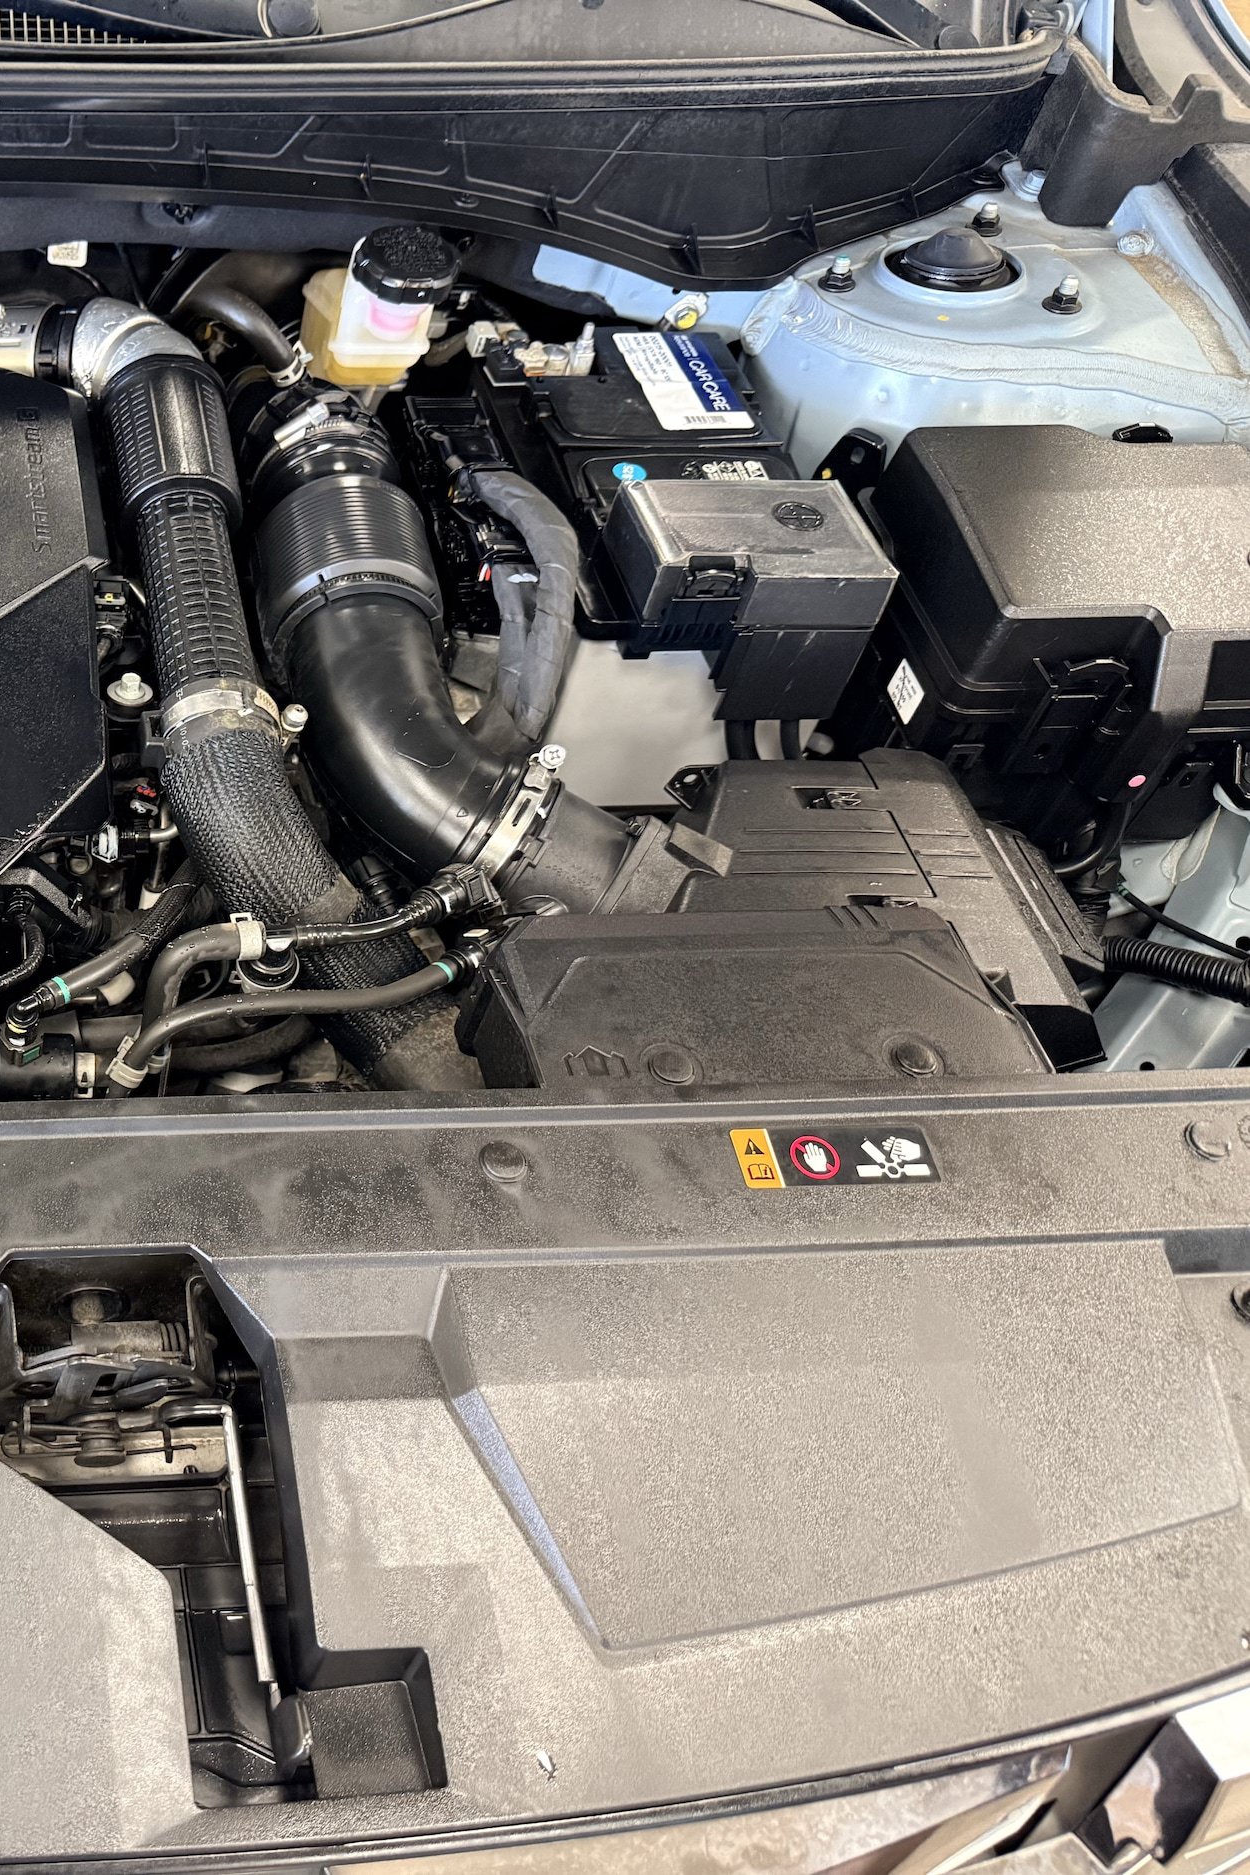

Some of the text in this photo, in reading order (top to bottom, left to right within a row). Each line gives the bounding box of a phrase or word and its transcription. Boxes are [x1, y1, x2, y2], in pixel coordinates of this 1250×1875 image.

[688, 360, 731, 411] CAR CARE
[25, 426, 52, 554] Smartstream
